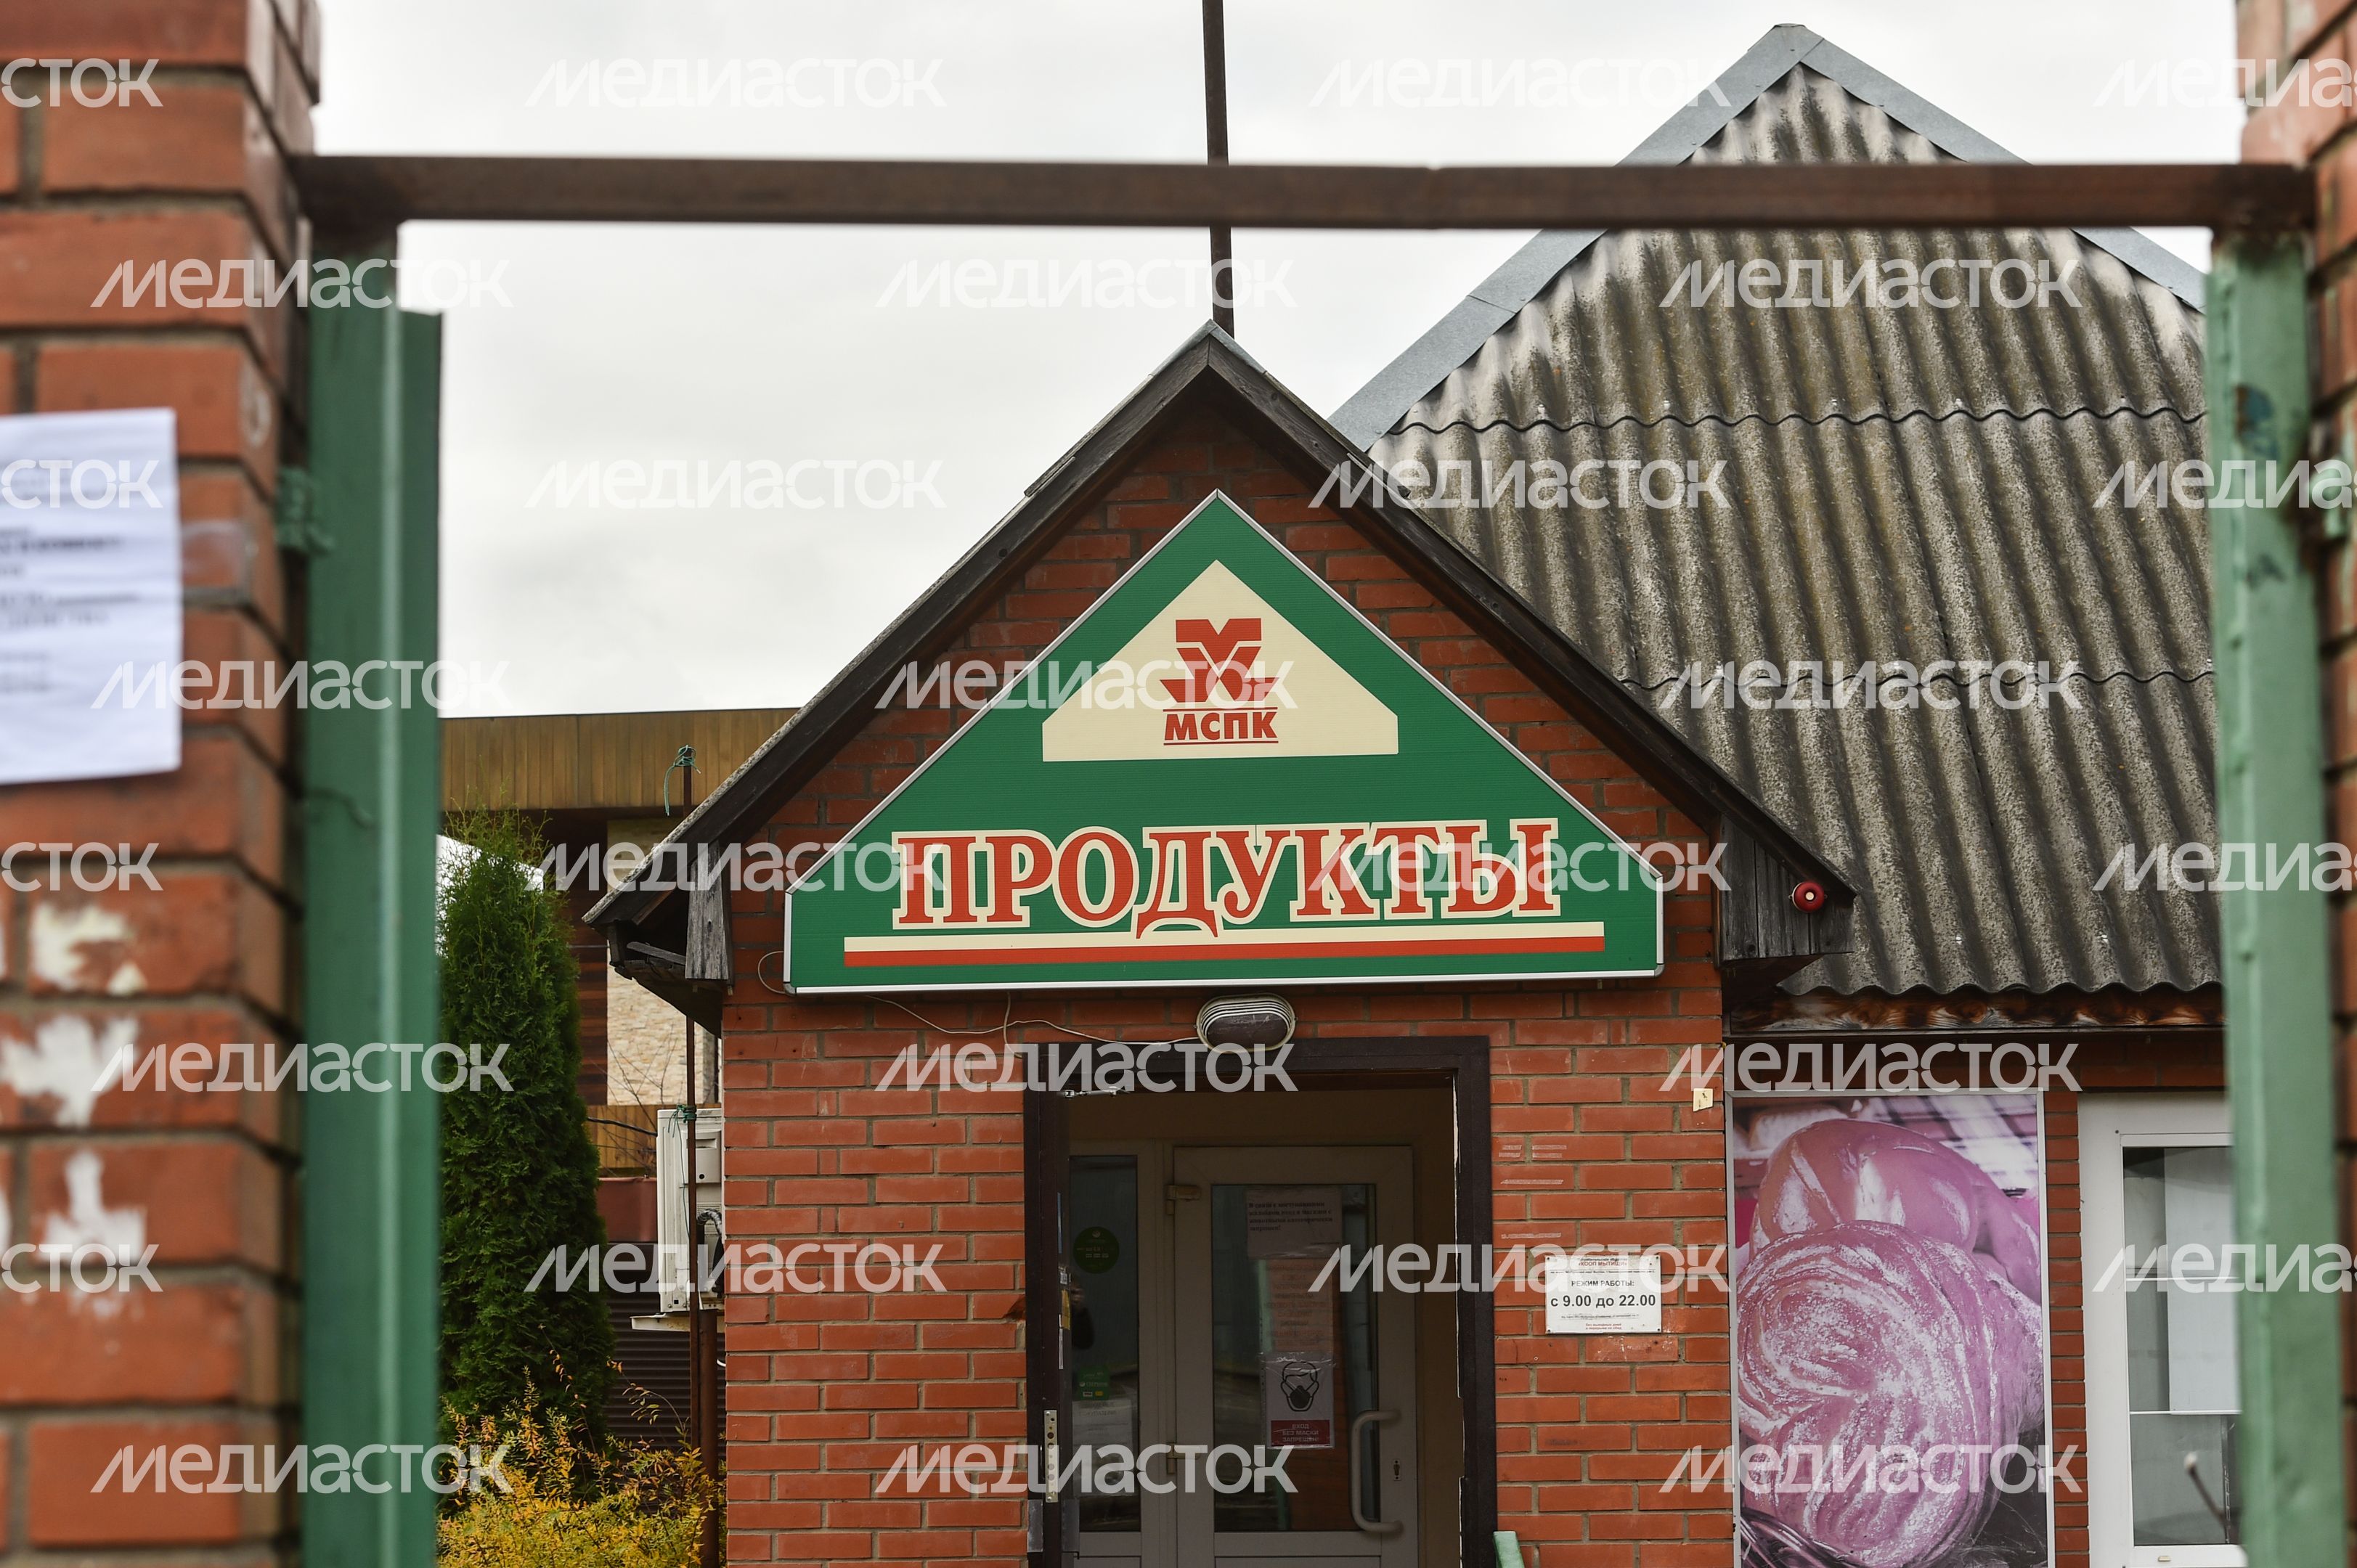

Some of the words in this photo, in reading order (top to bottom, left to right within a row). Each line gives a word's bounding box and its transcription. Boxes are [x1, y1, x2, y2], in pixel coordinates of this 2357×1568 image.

[1165, 711, 1278, 740] МСПК
[893, 819, 1560, 939] ПРОДУКТЫ
[1550, 1298, 1558, 1307] с
[1563, 1295, 1592, 1307] 9.00
[1596, 1297, 1614, 1308] до
[1619, 1294, 1656, 1307] 22.00
